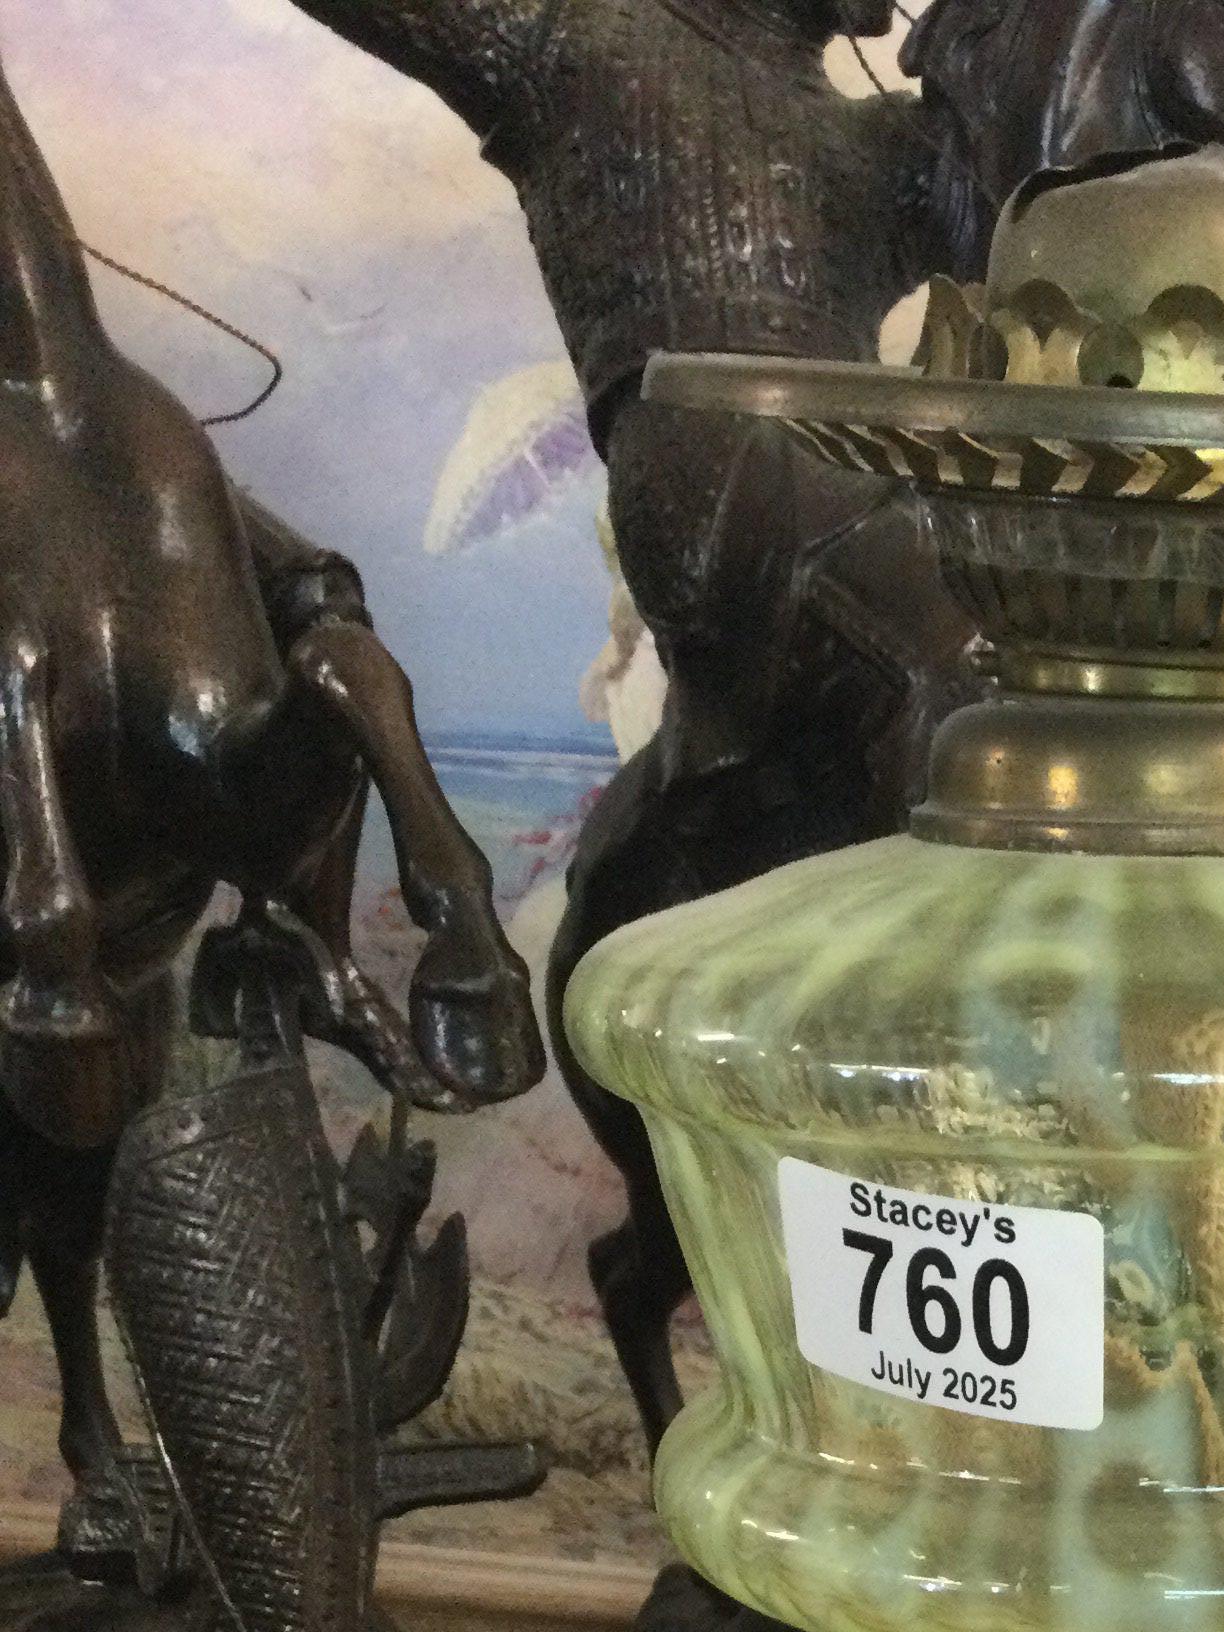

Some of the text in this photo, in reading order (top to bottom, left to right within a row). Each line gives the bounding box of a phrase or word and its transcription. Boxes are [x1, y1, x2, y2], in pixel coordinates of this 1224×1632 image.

[850, 1182, 1016, 1247] Stacey's
[842, 1227, 1030, 1367] 760
[871, 1351, 1018, 1411] July 2025
